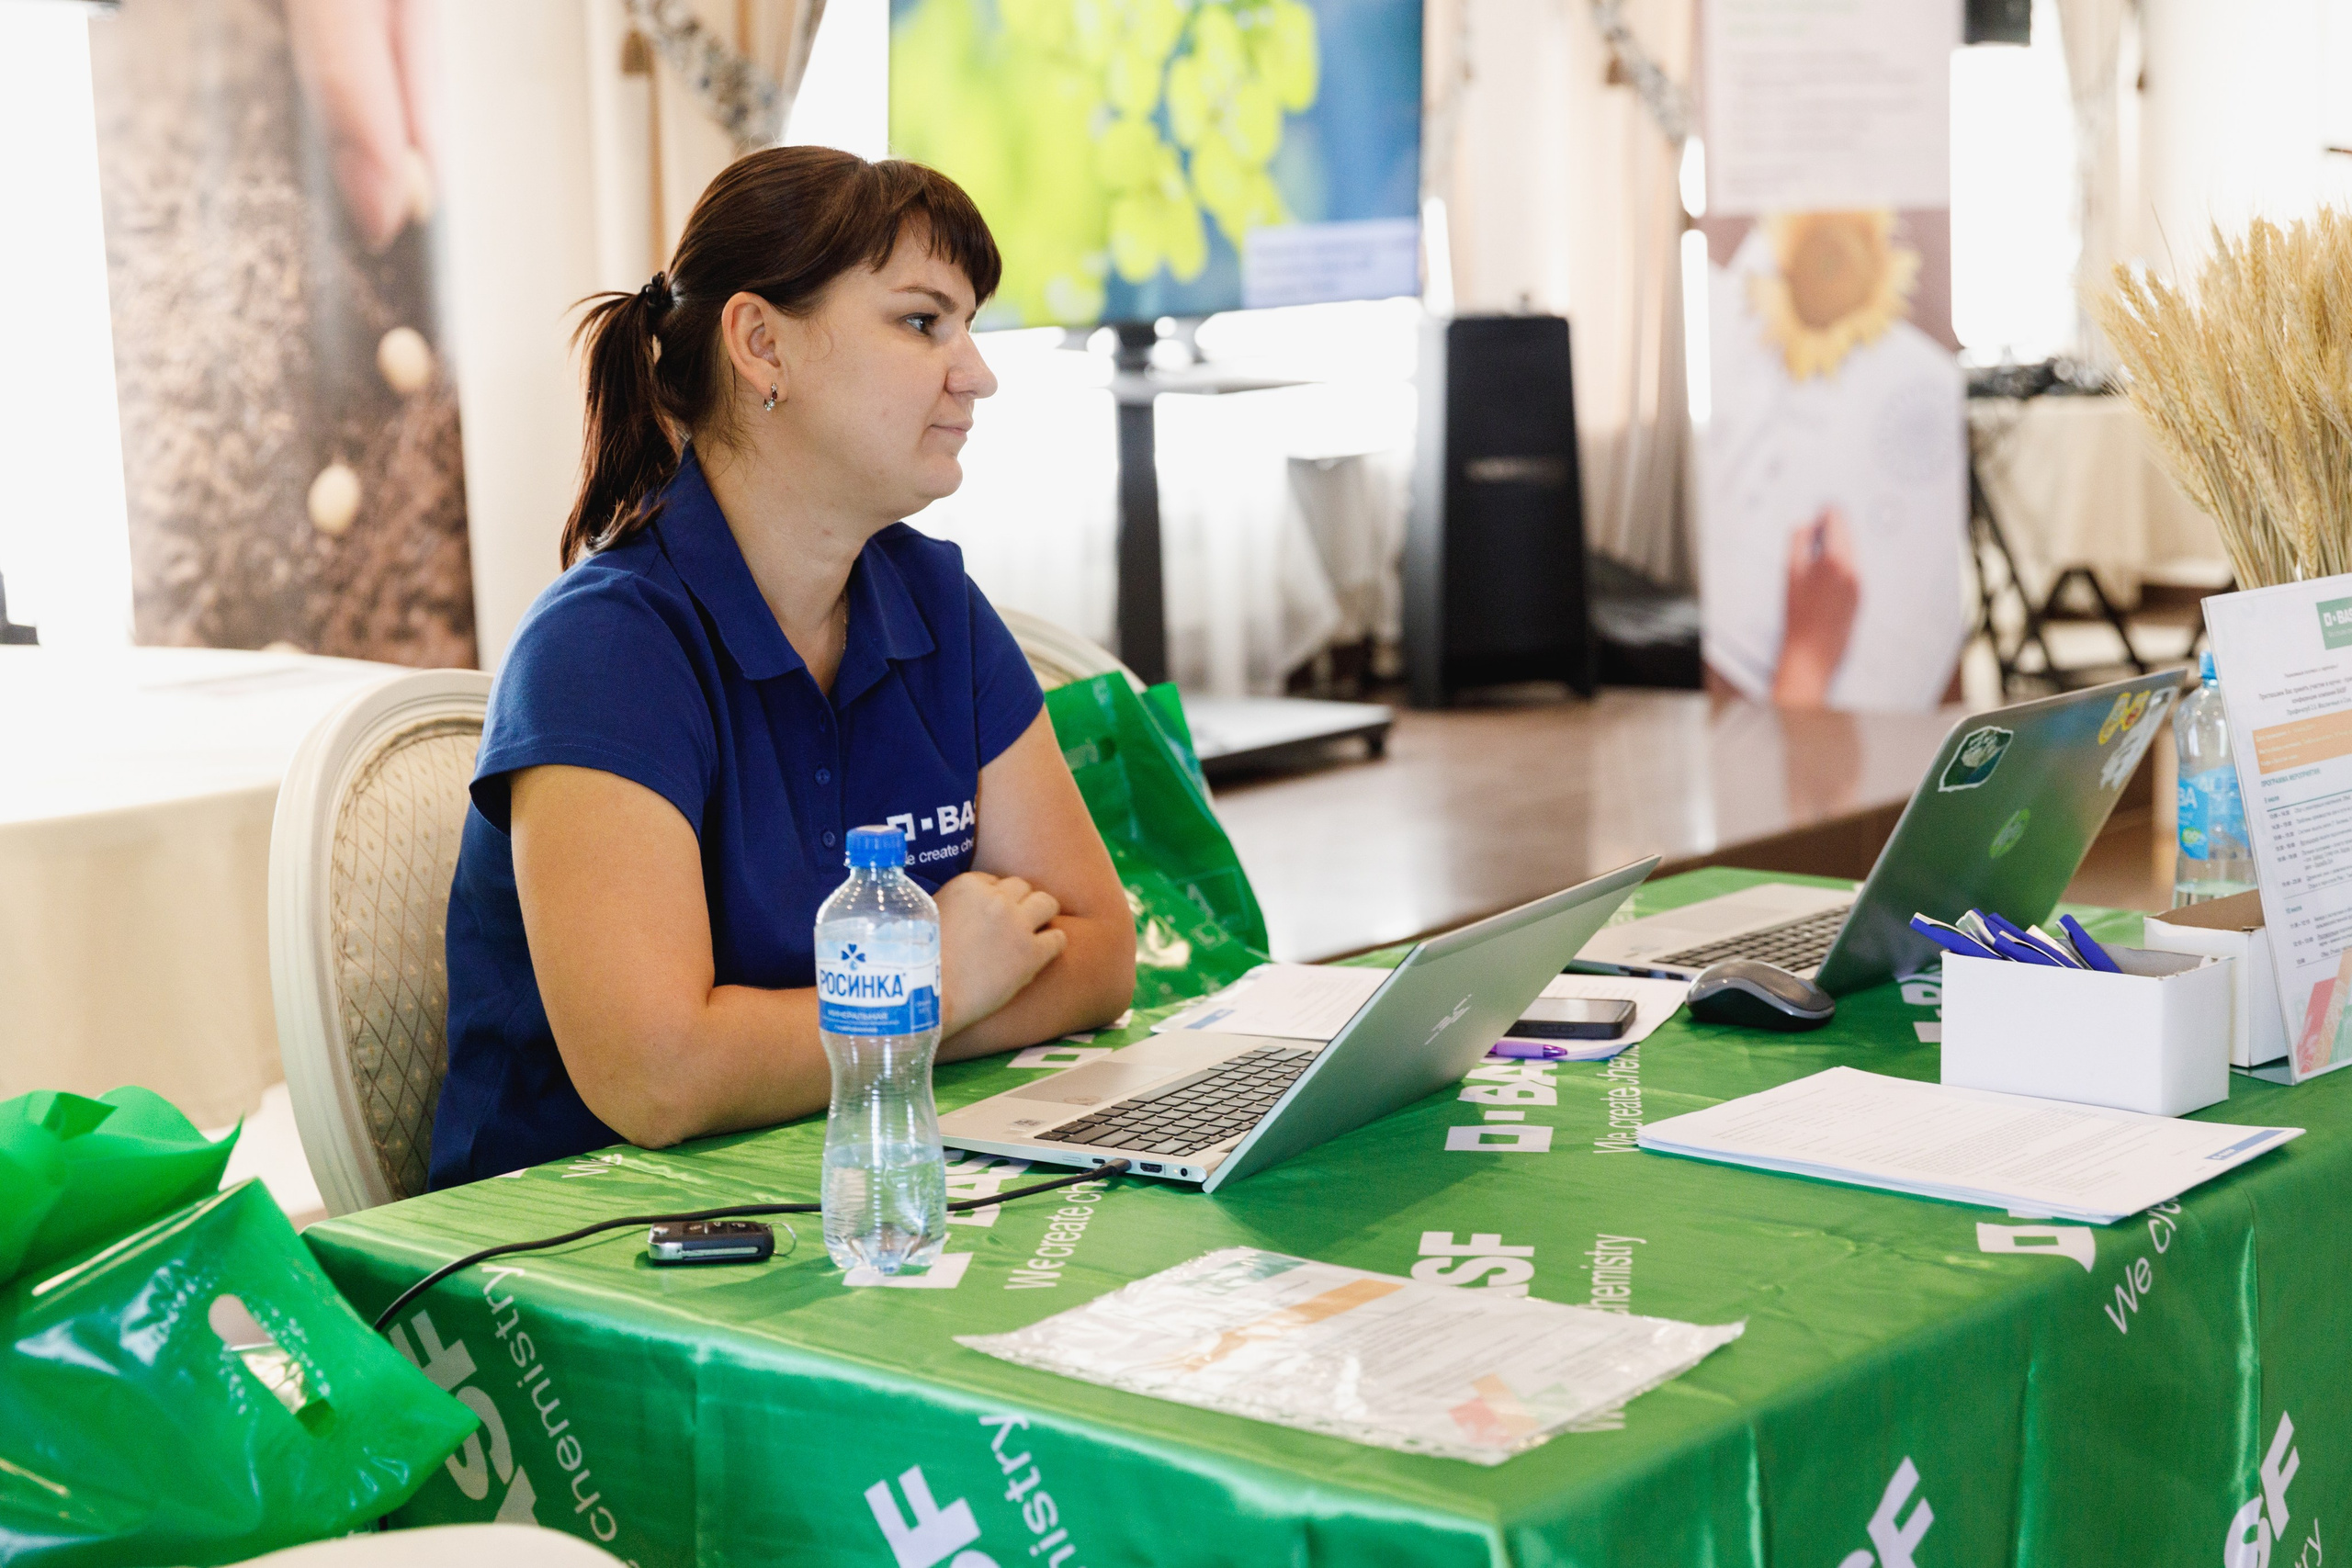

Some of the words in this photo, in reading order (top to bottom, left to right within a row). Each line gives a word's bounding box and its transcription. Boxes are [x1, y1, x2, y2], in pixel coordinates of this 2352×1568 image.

[936, 800, 976, 835] BA
[919, 845, 959, 863] create
[820, 969, 904, 998] РОСИНКА
[1600, 1086, 1644, 1129] create
[1003, 1258, 1066, 1290] We
[1035, 1205, 1094, 1258] create
[1576, 1234, 1646, 1316] hemistry
[2105, 1258, 2153, 1335] We
[481, 1266, 617, 1542] chemistry
